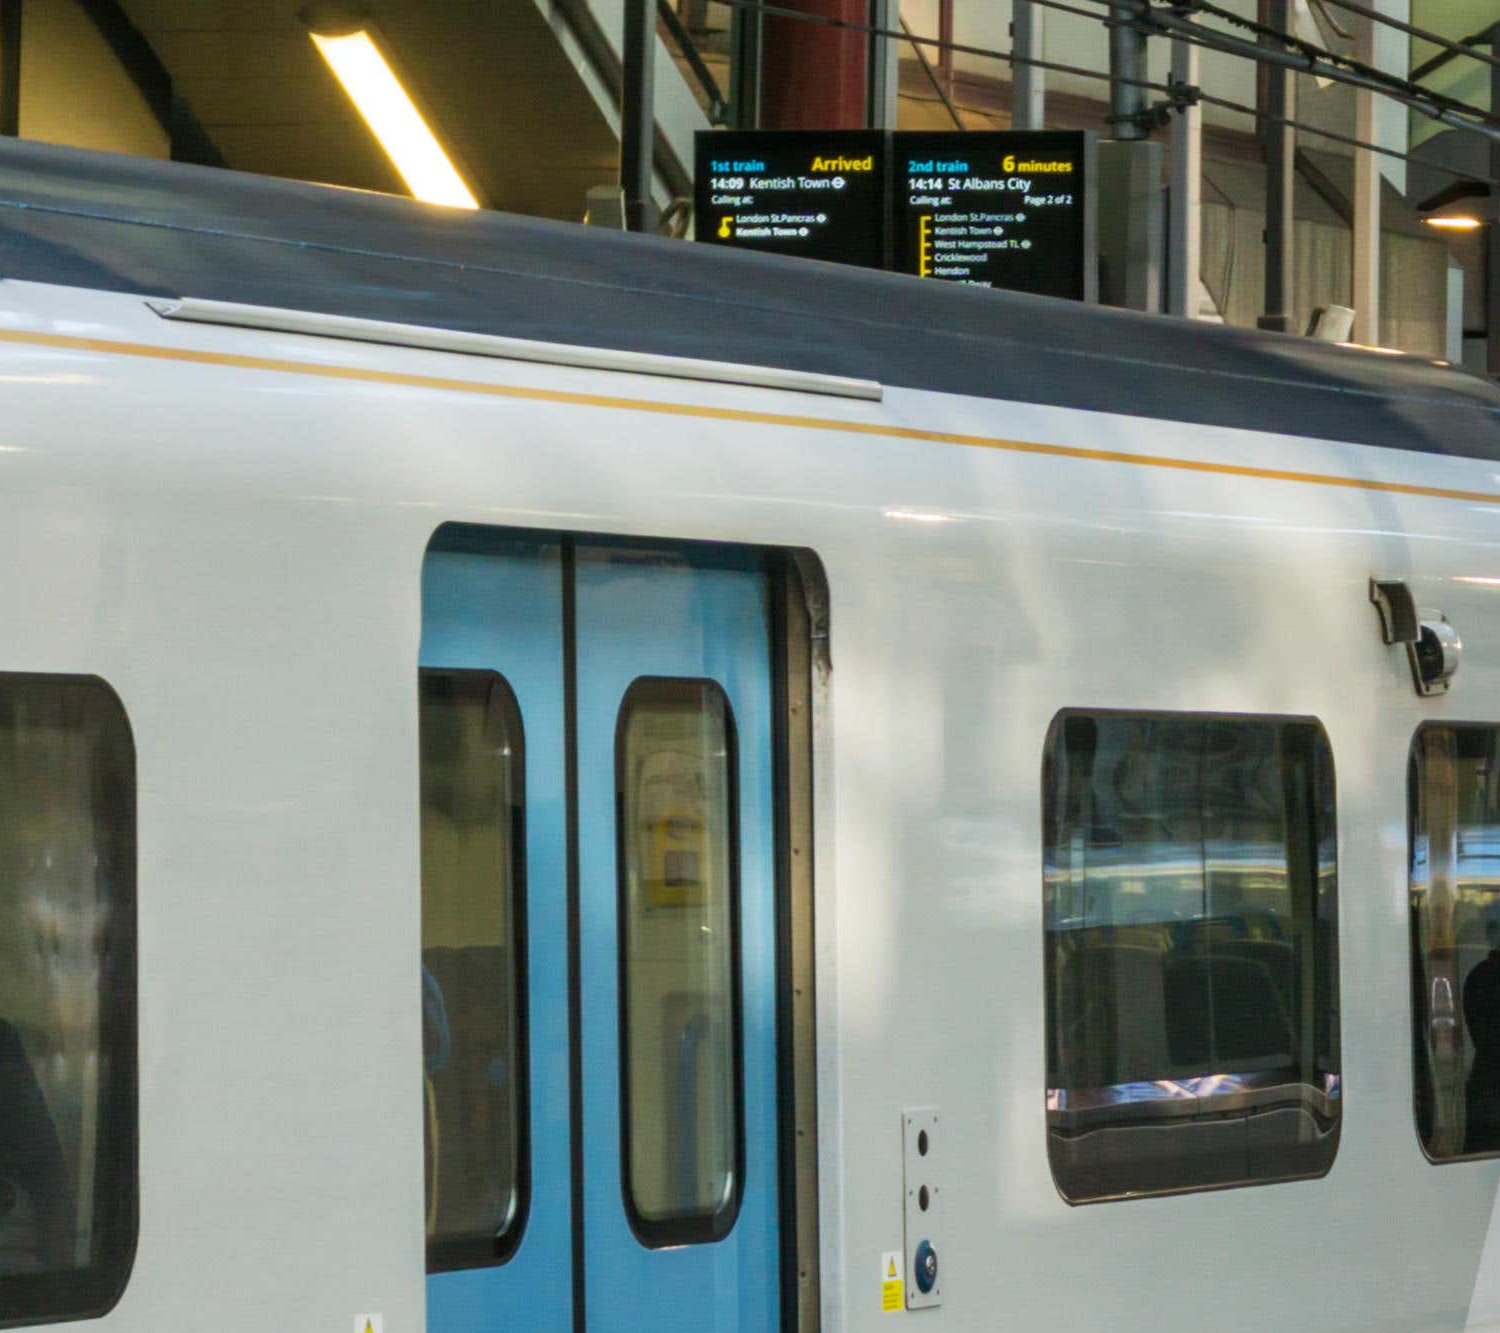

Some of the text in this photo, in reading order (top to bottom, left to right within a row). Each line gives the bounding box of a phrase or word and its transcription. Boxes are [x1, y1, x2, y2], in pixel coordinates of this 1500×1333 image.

[710, 159, 765, 172] 1st train
[811, 156, 873, 172] Arrived
[908, 159, 969, 173] 2nd train
[1003, 155, 1073, 173] 6 minutes
[710, 177, 830, 190] 14:09 Kentish Town
[908, 177, 1031, 193] 14:14 St Albans City
[711, 195, 741, 206] Calling
[909, 195, 939, 207] Calling
[1024, 195, 1046, 207] Page
[1054, 195, 1064, 205] of
[1065, 195, 1073, 205] 2
[736, 214, 769, 224] London
[934, 213, 968, 222] London
[735, 227, 798, 237] Kentish Town
[934, 226, 992, 235] Kentish Town
[934, 240, 956, 249] West
[958, 240, 1008, 250] Hampstead
[934, 253, 988, 262] Cricklewood
[934, 267, 970, 276] Hendon
